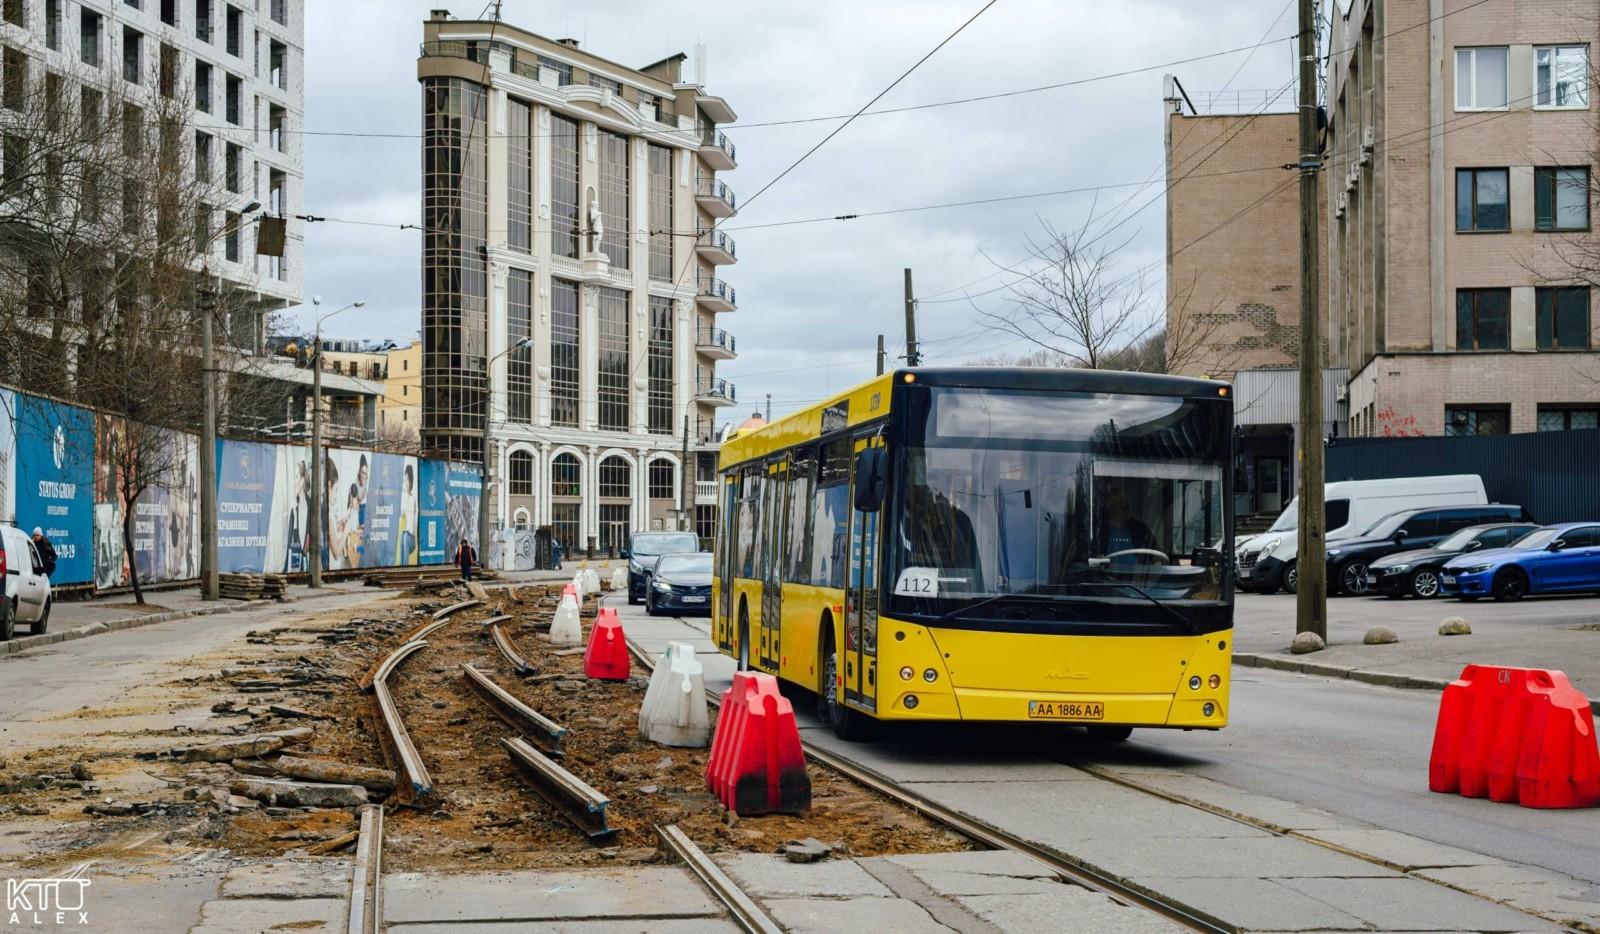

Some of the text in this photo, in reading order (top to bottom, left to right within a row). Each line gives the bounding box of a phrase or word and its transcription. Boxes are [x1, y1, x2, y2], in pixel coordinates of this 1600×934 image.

[38, 480, 76, 500] STATUS GROUP
[220, 502, 262, 513] СУПЕРМАРКЕТ
[217, 536, 245, 547] АГАЗИНИ
[902, 578, 931, 593] 112
[1038, 704, 1101, 717] AA 1886 AA
